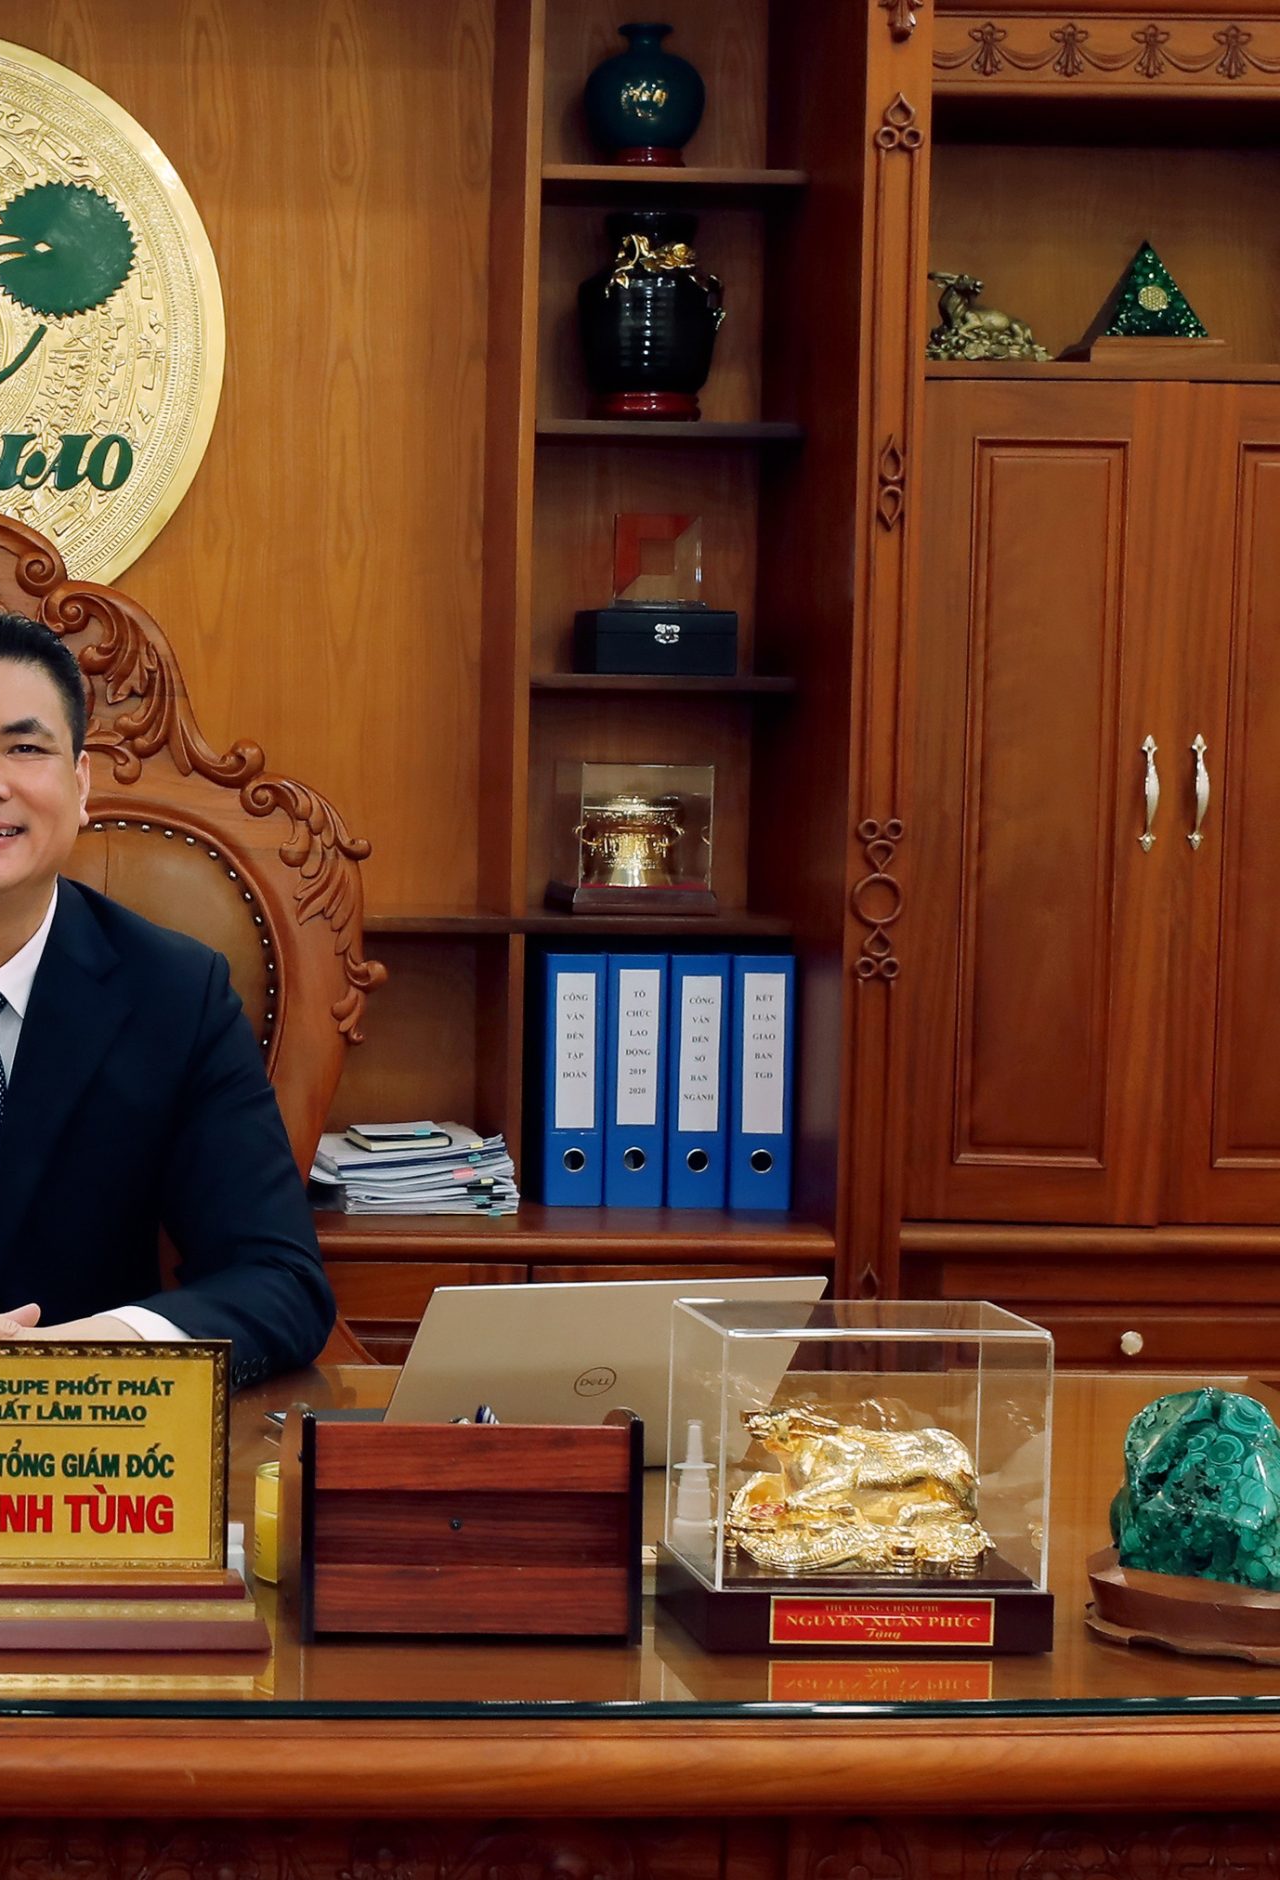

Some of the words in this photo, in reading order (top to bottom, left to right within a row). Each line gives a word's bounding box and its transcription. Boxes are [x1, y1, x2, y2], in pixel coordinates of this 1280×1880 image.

[563, 992, 588, 1001] CÔNG
[689, 995, 714, 1004] CÔNG
[566, 1012, 585, 1020] VĂN
[626, 1009, 652, 1017] CHỨC
[629, 1029, 648, 1037] LAO
[625, 1048, 651, 1056] ĐỘNG
[56, 1374, 112, 1395] PHỐT
[118, 1377, 174, 1395] PHÁT
[37, 1401, 82, 1420] LÂM
[88, 1405, 147, 1420] THAO
[62, 1447, 119, 1477] GIÁM
[126, 1442, 175, 1478] ĐỐC
[64, 1484, 174, 1534] TÙNG
[786, 1613, 865, 1626] NGUYỄN
[871, 1613, 923, 1627] XUÂN
[928, 1614, 981, 1628] PHÚC
